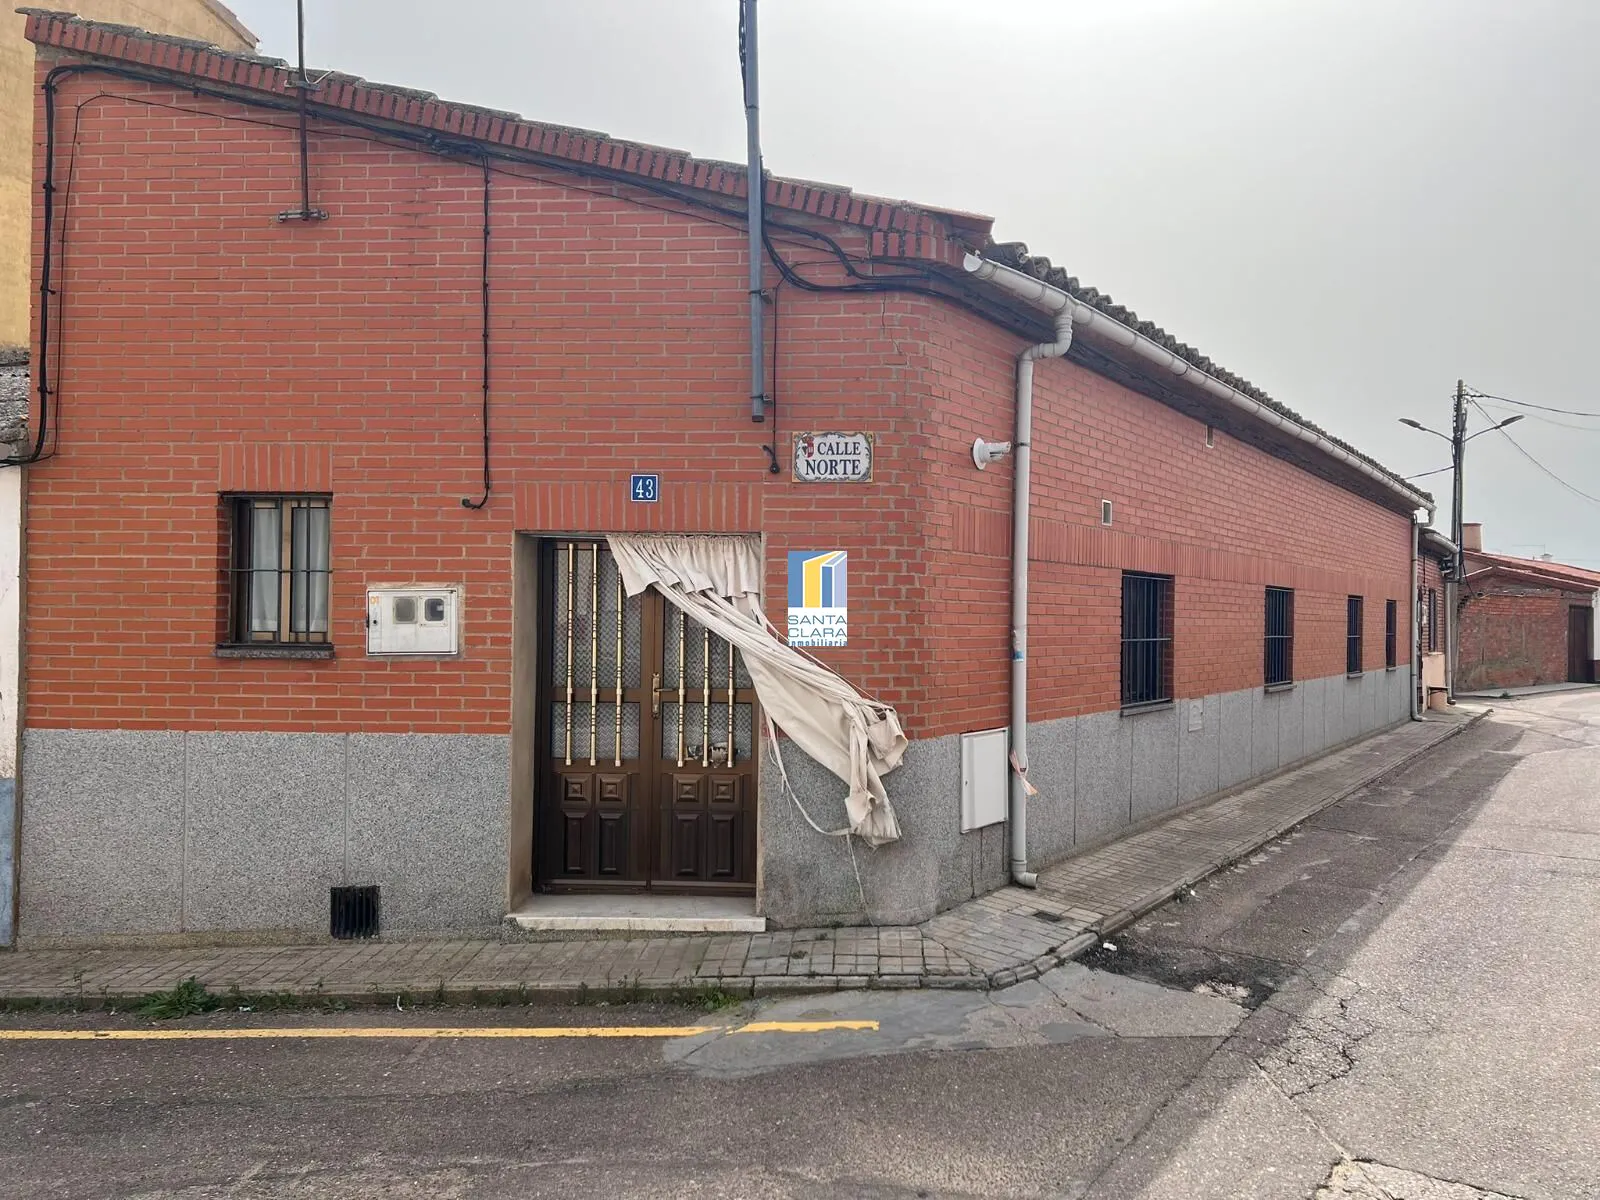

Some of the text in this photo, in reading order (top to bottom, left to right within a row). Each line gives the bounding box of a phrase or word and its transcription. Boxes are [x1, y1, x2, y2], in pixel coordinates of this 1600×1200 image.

[817, 441, 861, 456] CALLE
[805, 459, 861, 476] NORTE
[635, 478, 653, 498] 43
